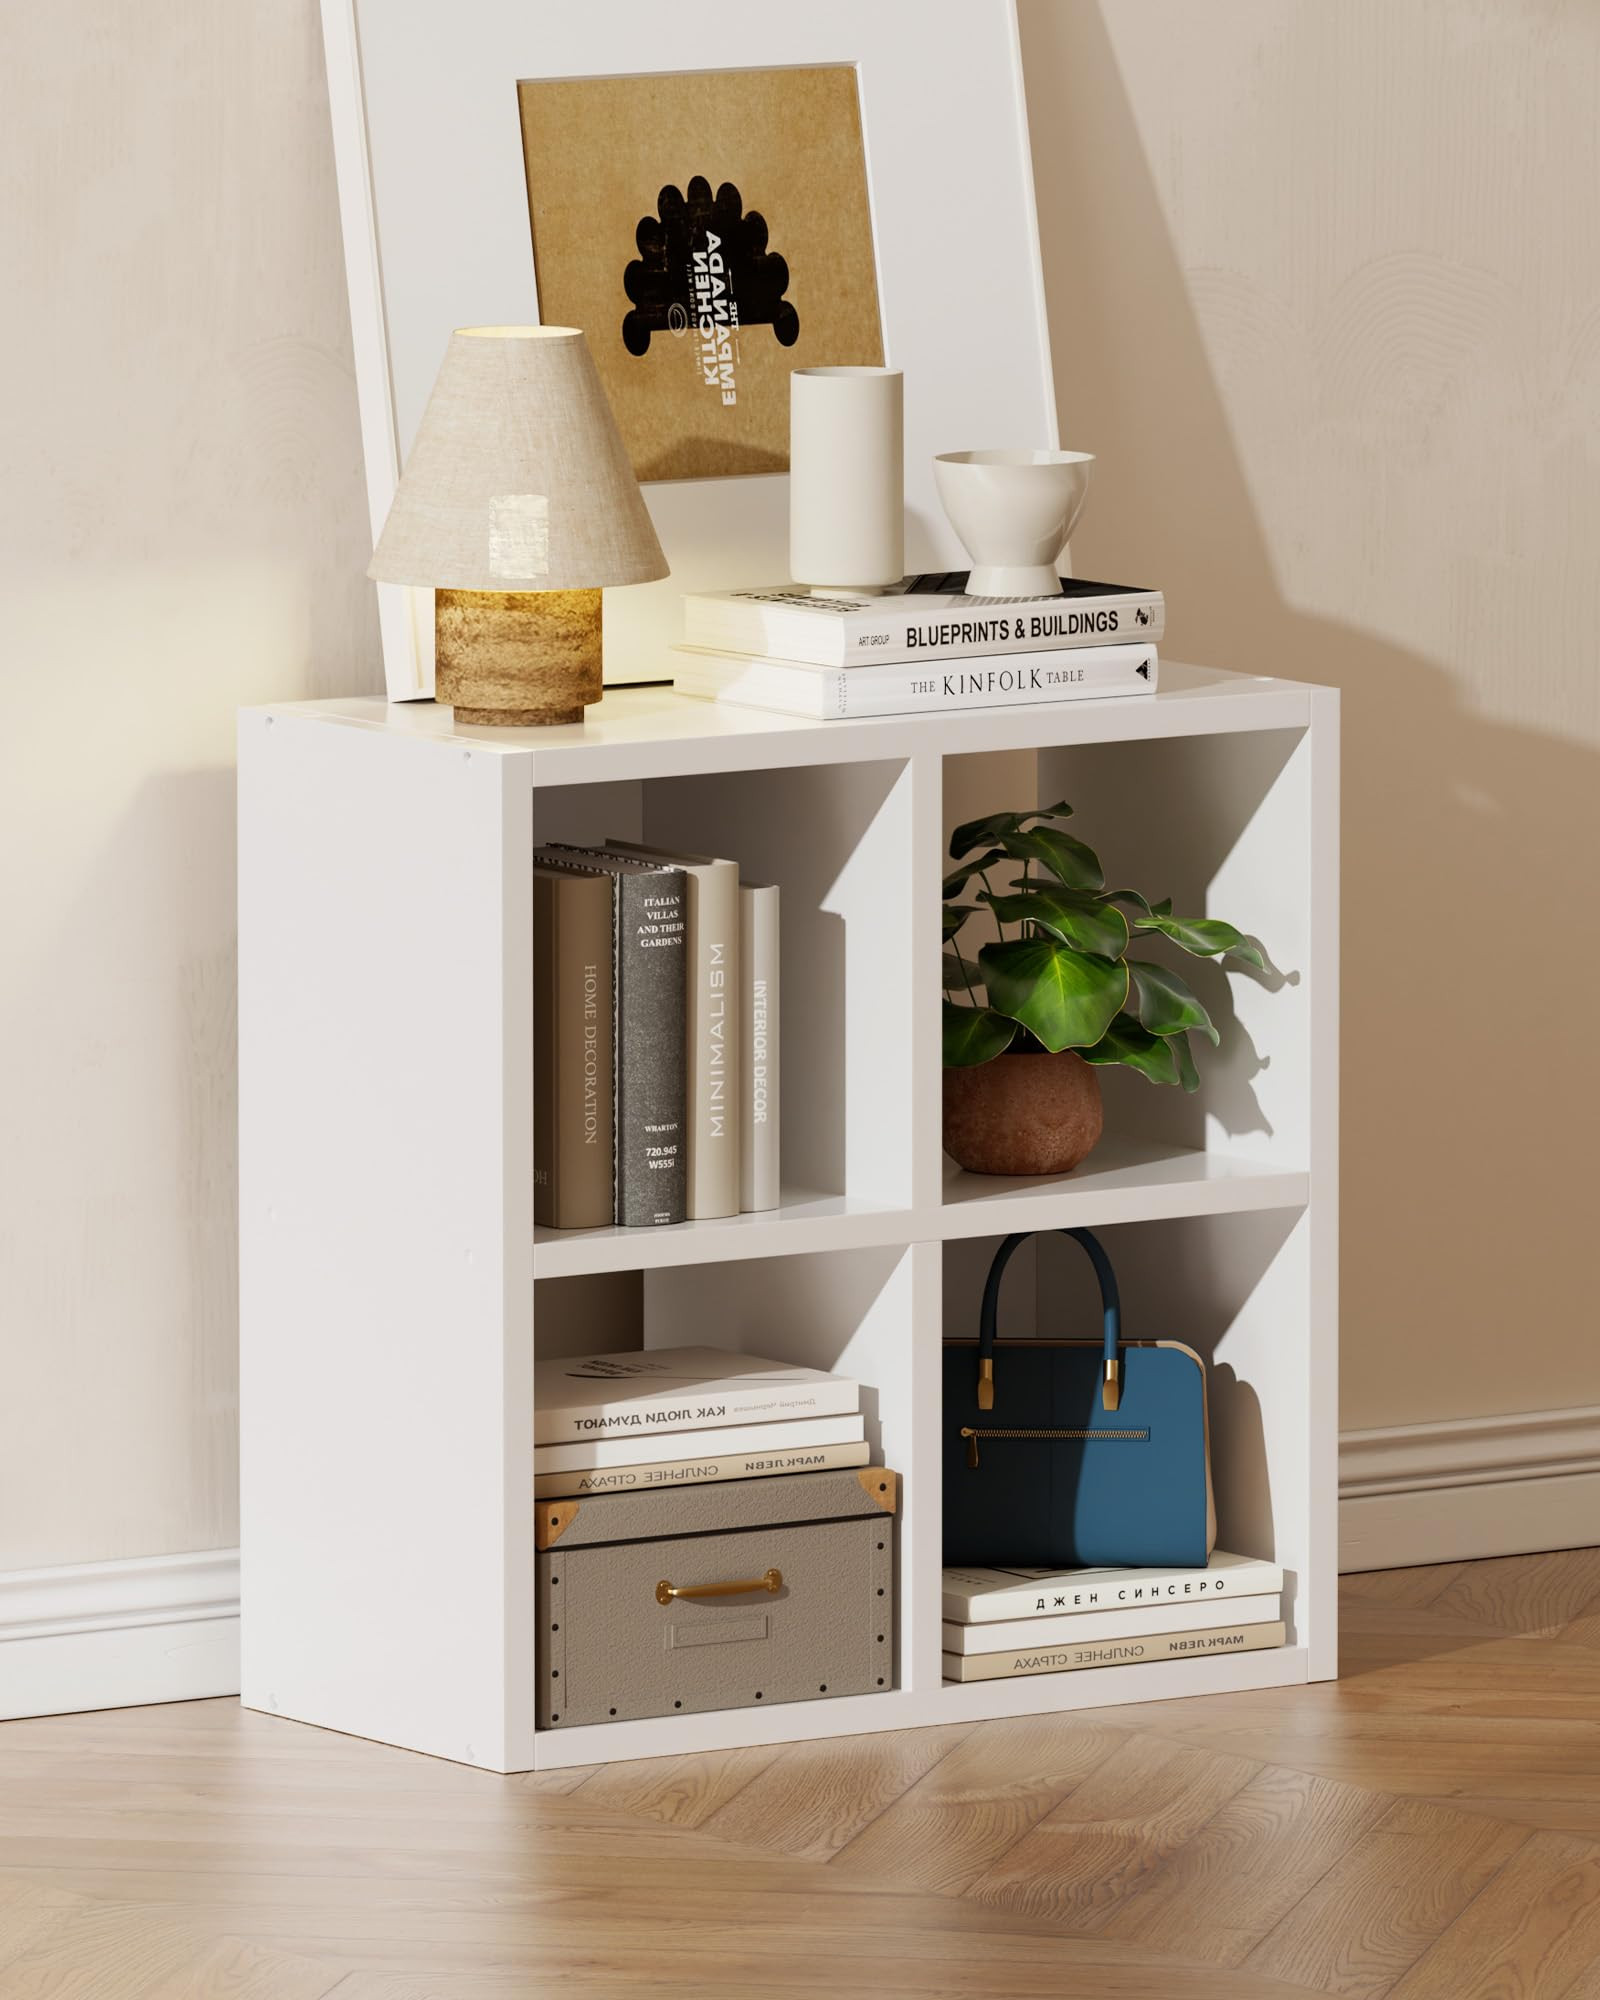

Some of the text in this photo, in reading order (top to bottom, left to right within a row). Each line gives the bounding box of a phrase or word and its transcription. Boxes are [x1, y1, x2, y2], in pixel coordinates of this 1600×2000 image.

[859, 610, 1119, 648] ART GROUP BLUEPRINTS & BUILDINGS
[911, 668, 1084, 695] THE KINFOLK TABLE
[644, 896, 680, 907] ITALIAN
[646, 910, 679, 920] VILLAS
[637, 922, 685, 935] AND THEIR
[640, 936, 682, 948] GARDENS
[710, 943, 725, 1138] MINIMALISM
[584, 965, 597, 1145] HOME DECORATION
[753, 979, 767, 1124] INTERIOR DECOR
[644, 1122, 679, 1133] WHARTON
[645, 1145, 678, 1157] 720.945
[1036, 1580, 1225, 1611] ДЖЕН СИНСЕРО
